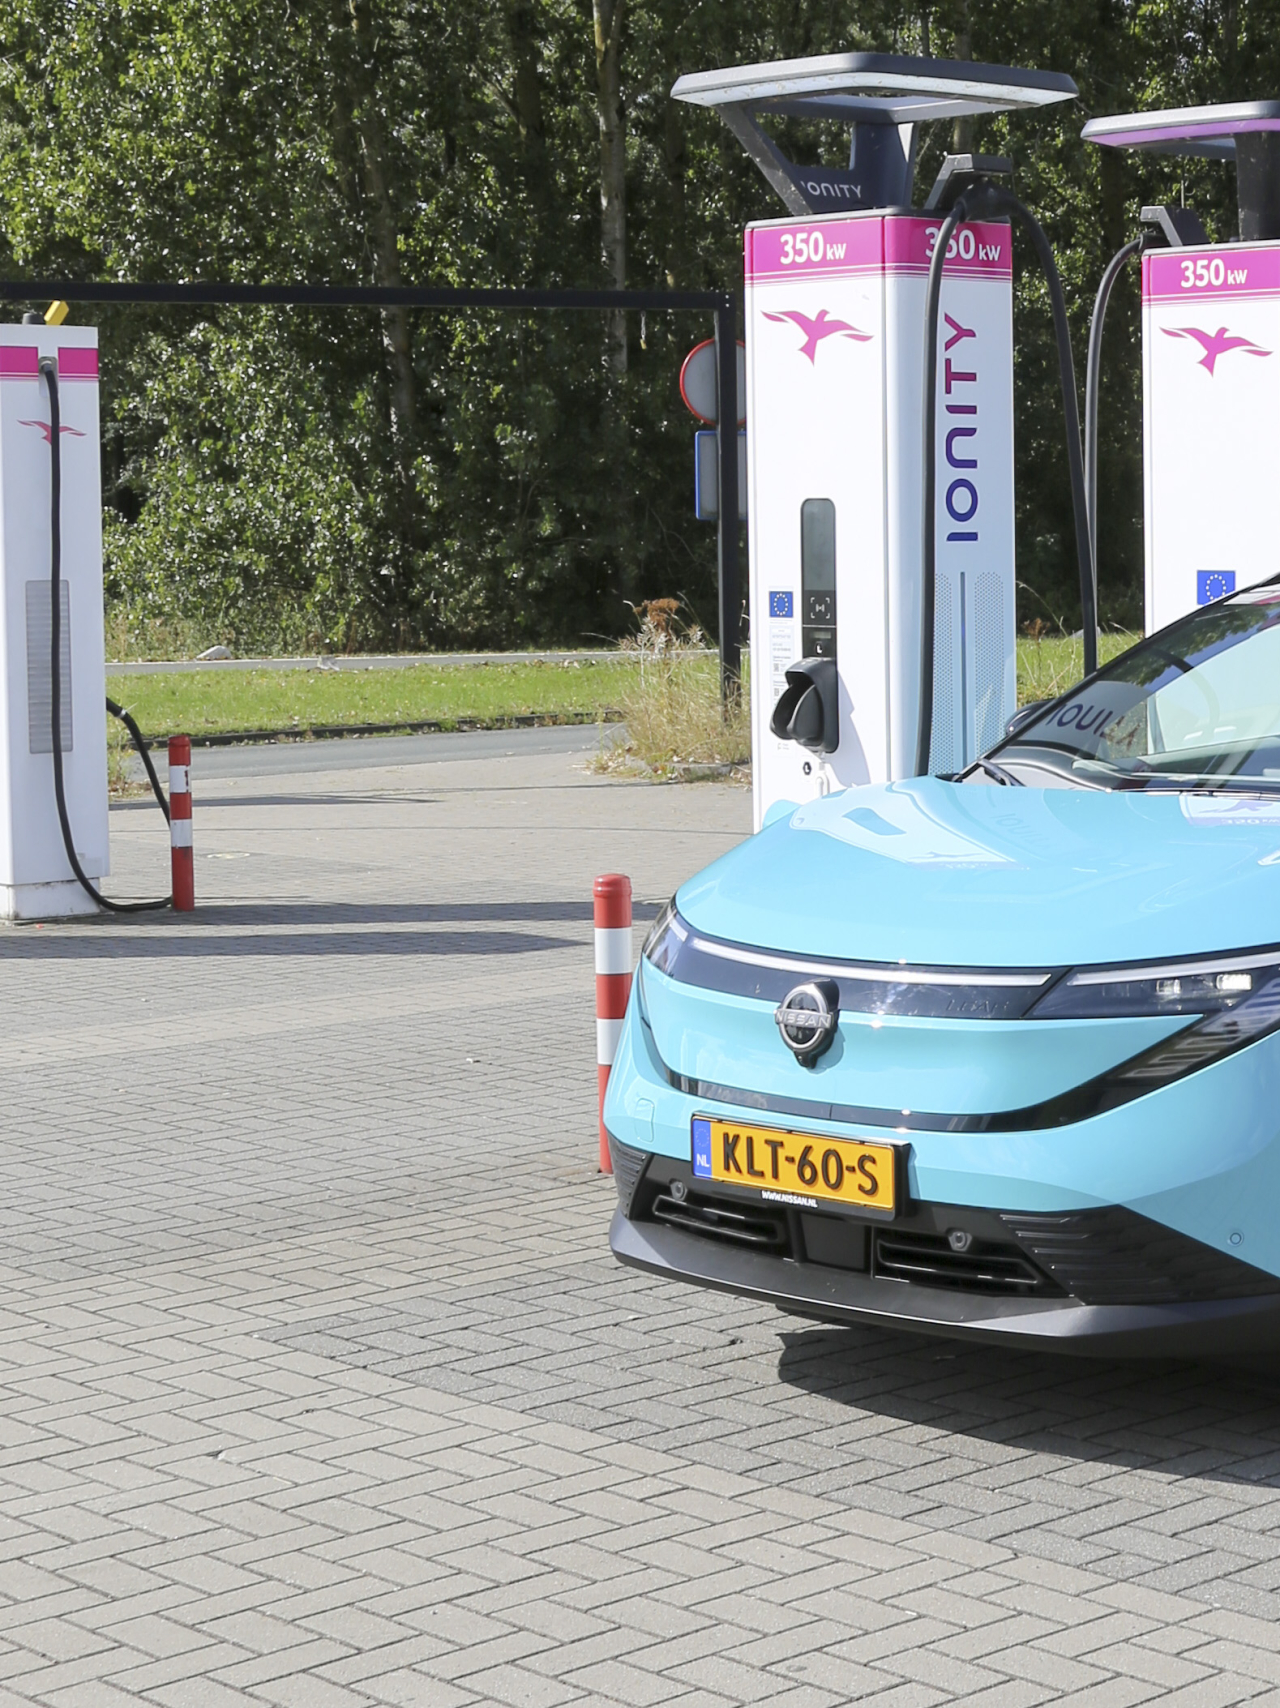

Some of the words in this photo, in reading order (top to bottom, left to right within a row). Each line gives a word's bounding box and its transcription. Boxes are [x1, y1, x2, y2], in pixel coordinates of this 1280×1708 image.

[780, 232, 824, 265] 350
[826, 243, 847, 261] kW
[978, 243, 1001, 262] kW
[1180, 258, 1225, 288] 350
[1227, 269, 1248, 285] kW
[944, 311, 979, 542] IONITY
[775, 1009, 831, 1029] NISSAN
[696, 1153, 710, 1169] NL
[722, 1132, 879, 1196] KLT-60-S
